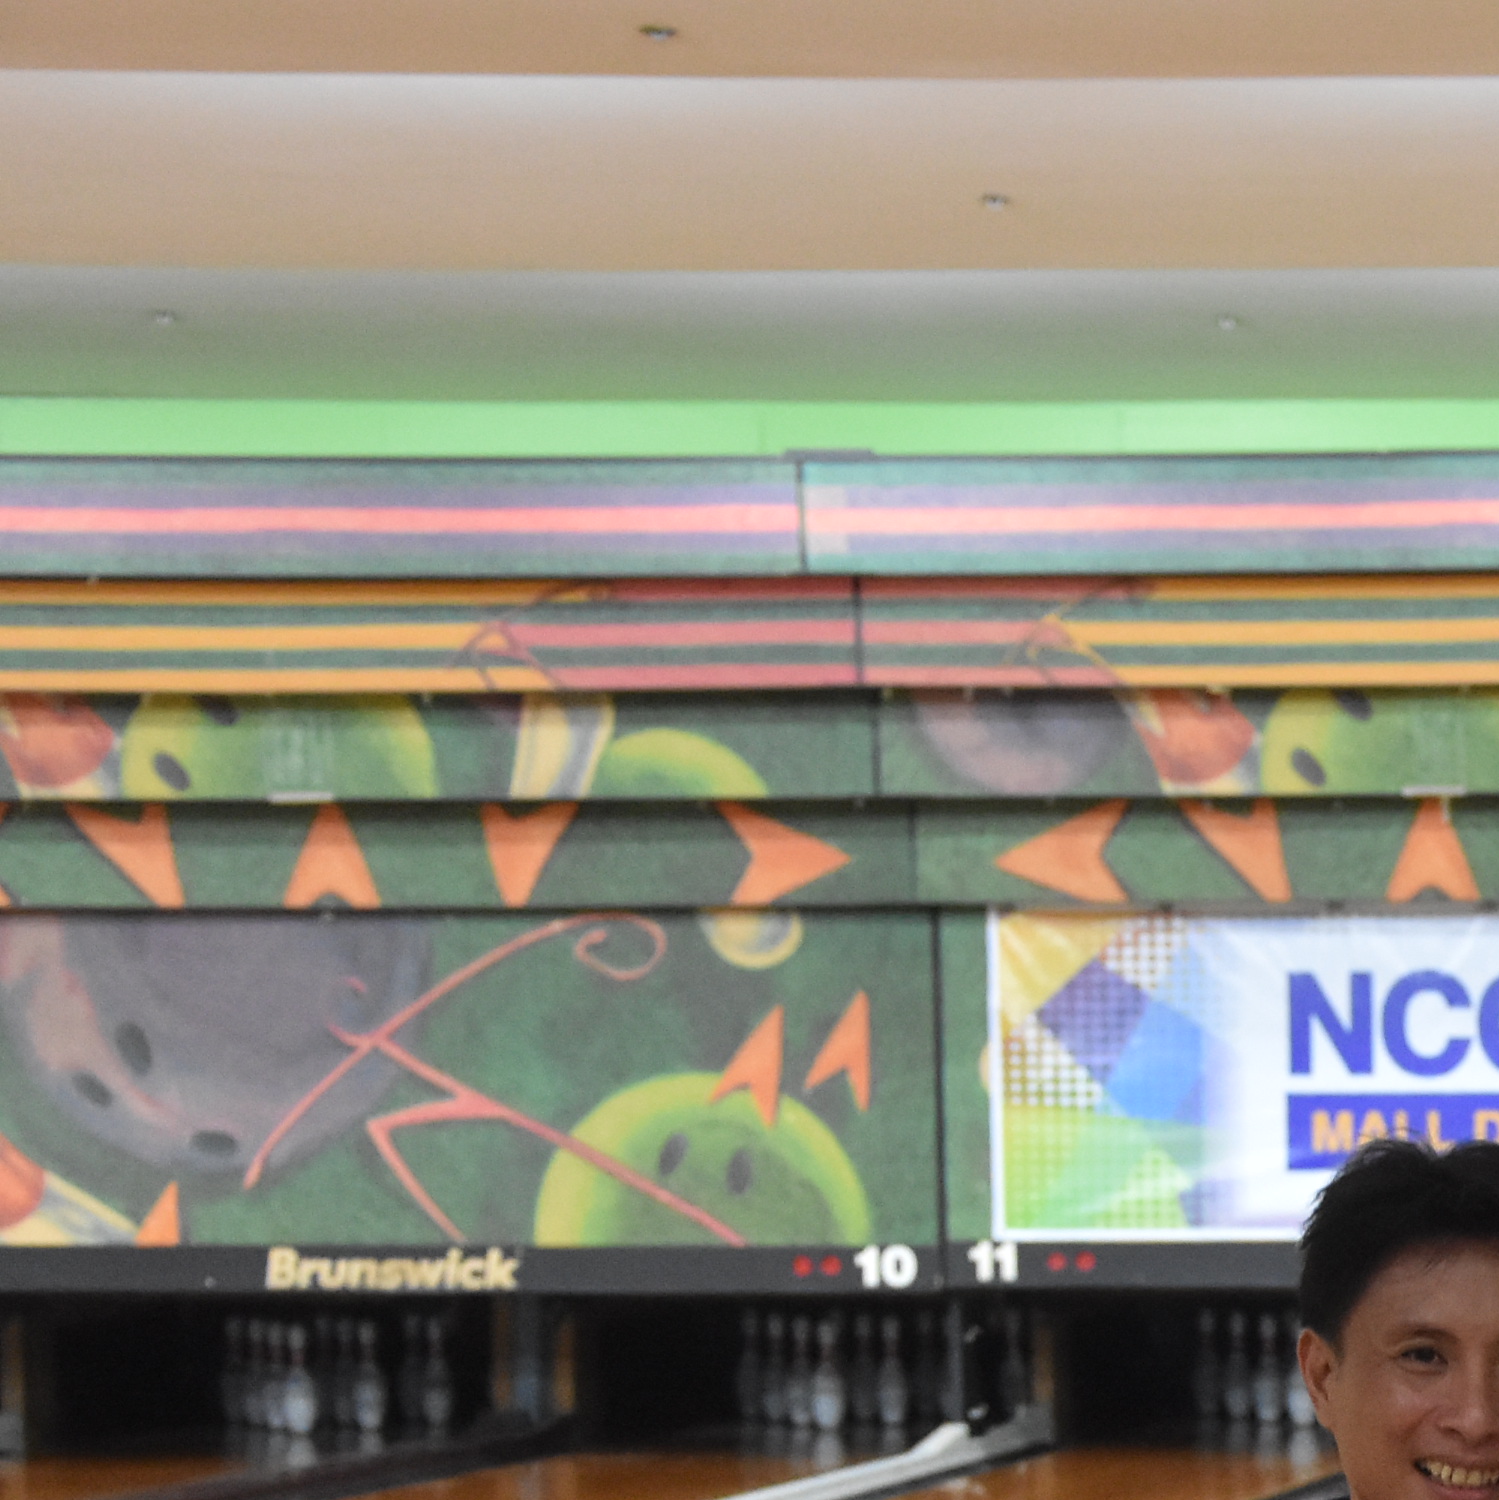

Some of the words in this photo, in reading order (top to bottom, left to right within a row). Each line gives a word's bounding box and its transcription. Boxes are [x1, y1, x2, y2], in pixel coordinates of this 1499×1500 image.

[265, 1245, 520, 1291] Brunswick
[853, 1248, 917, 1287] 10
[968, 1241, 1019, 1283] 11
